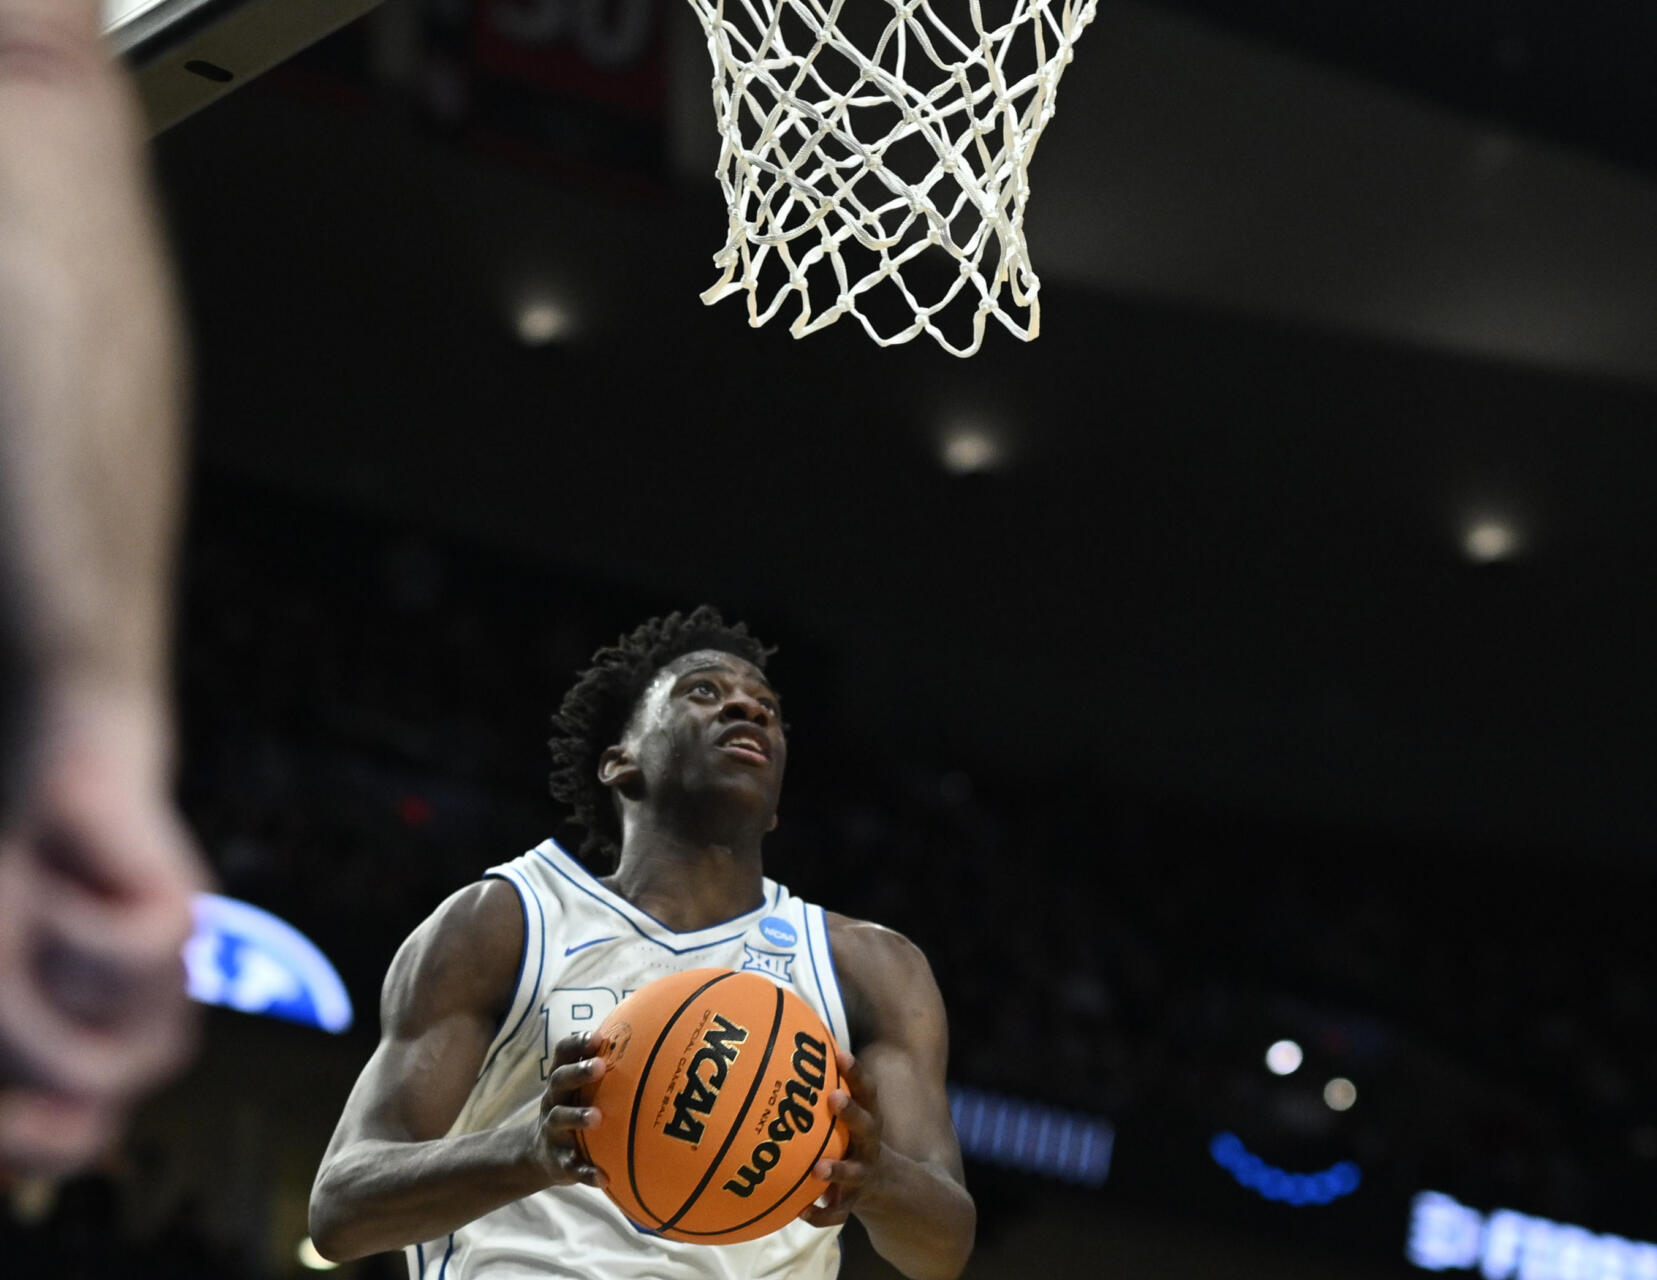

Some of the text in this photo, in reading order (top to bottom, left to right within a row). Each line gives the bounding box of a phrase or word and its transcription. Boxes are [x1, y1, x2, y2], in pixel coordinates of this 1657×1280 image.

[663, 1012, 749, 1145] NCAA
[722, 1031, 828, 1198] Wilson
[755, 1080, 782, 1135] EVO NXT
